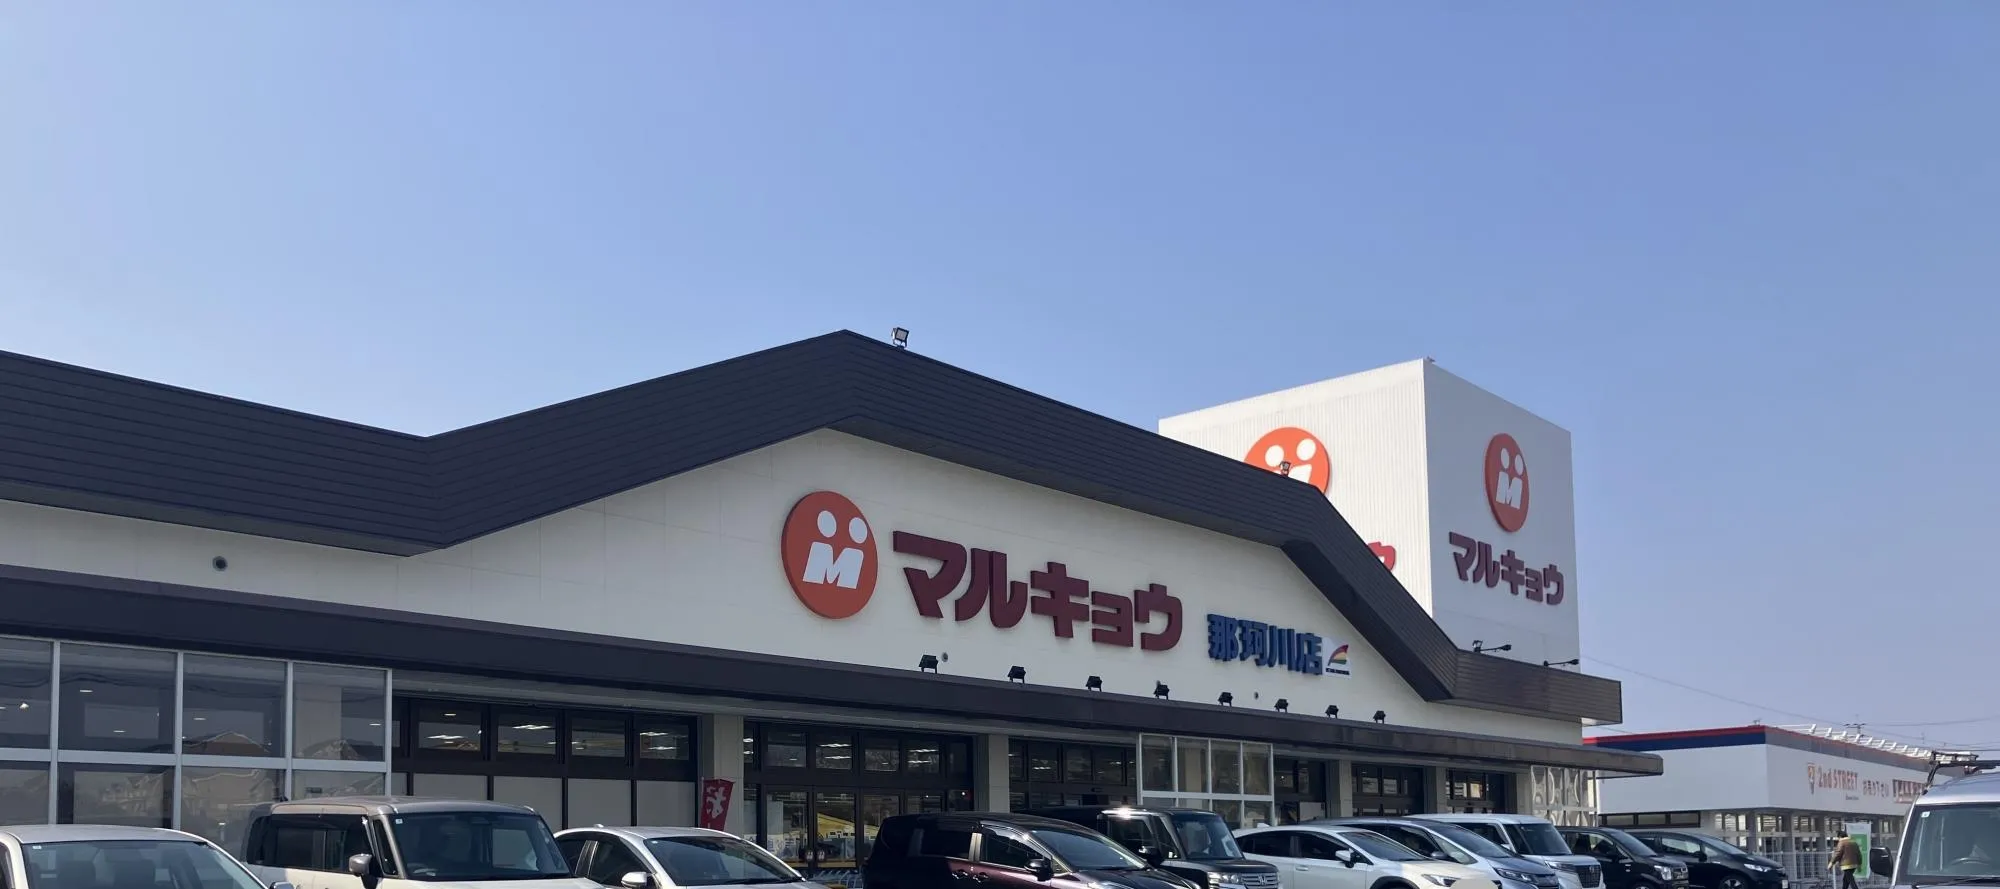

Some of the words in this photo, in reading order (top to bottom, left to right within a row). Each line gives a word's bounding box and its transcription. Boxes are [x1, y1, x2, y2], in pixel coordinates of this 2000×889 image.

[802, 541, 865, 590] M
[893, 530, 1183, 651] マルキョウ
[1449, 531, 1564, 606] マルキョウ
[1207, 613, 1323, 676] 那珂川店
[1818, 765, 1832, 789] 2nd
[1833, 769, 1859, 791] STREET
